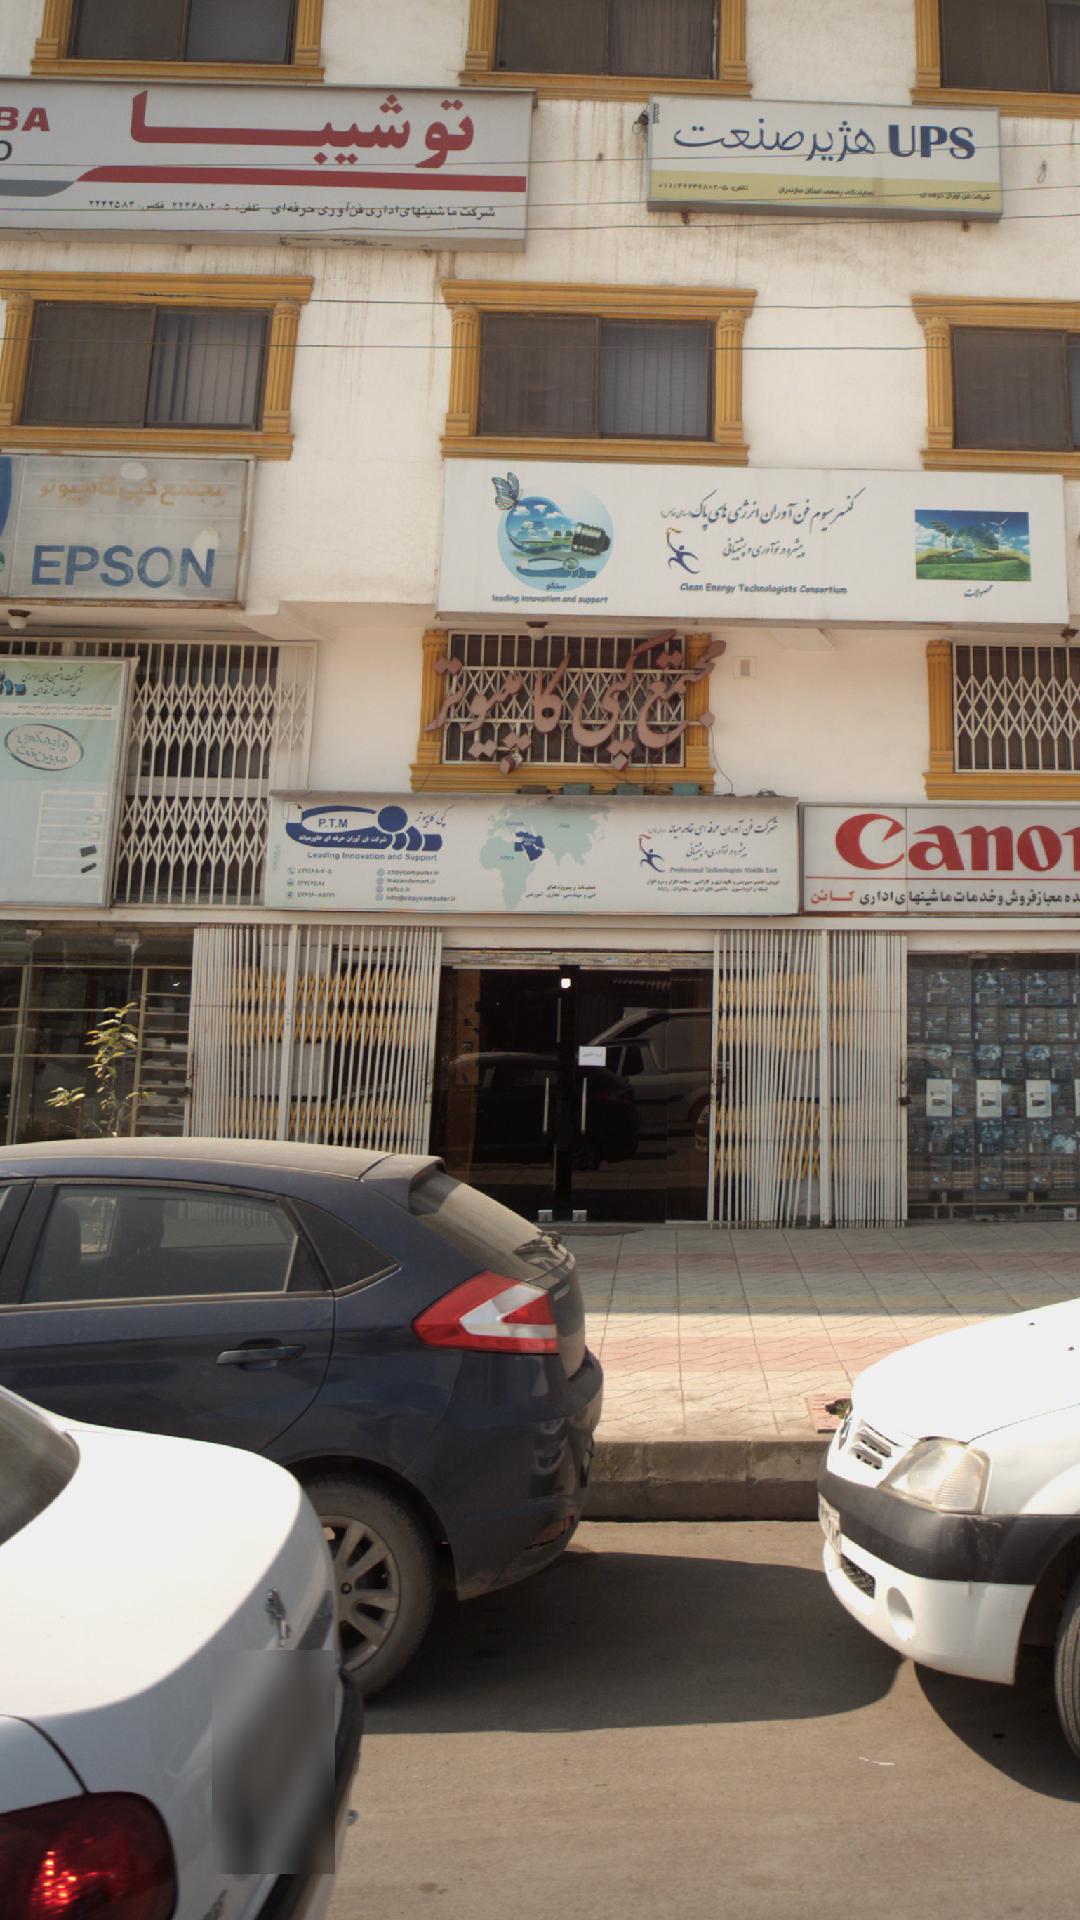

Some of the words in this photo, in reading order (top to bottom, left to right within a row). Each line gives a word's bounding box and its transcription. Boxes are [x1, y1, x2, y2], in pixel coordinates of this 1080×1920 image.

[130, 89, 475, 169] توشیبا
[673, 118, 806, 151] صنعت
[887, 124, 976, 160] UPS
[459, 205, 497, 220] شرکت
[31, 543, 216, 588] EPSON
[680, 582, 704, 592] Clean
[705, 583, 736, 597] Energy
[739, 583, 798, 596] Technologists
[799, 585, 849, 595] Consortium
[562, 595, 577, 603] and
[578, 595, 609, 605] support
[307, 851, 341, 861] Leading
[342, 852, 386, 860] Innovation
[404, 853, 438, 863] Support
[859, 889, 894, 906] اداری
[953, 889, 998, 903] خدمات
